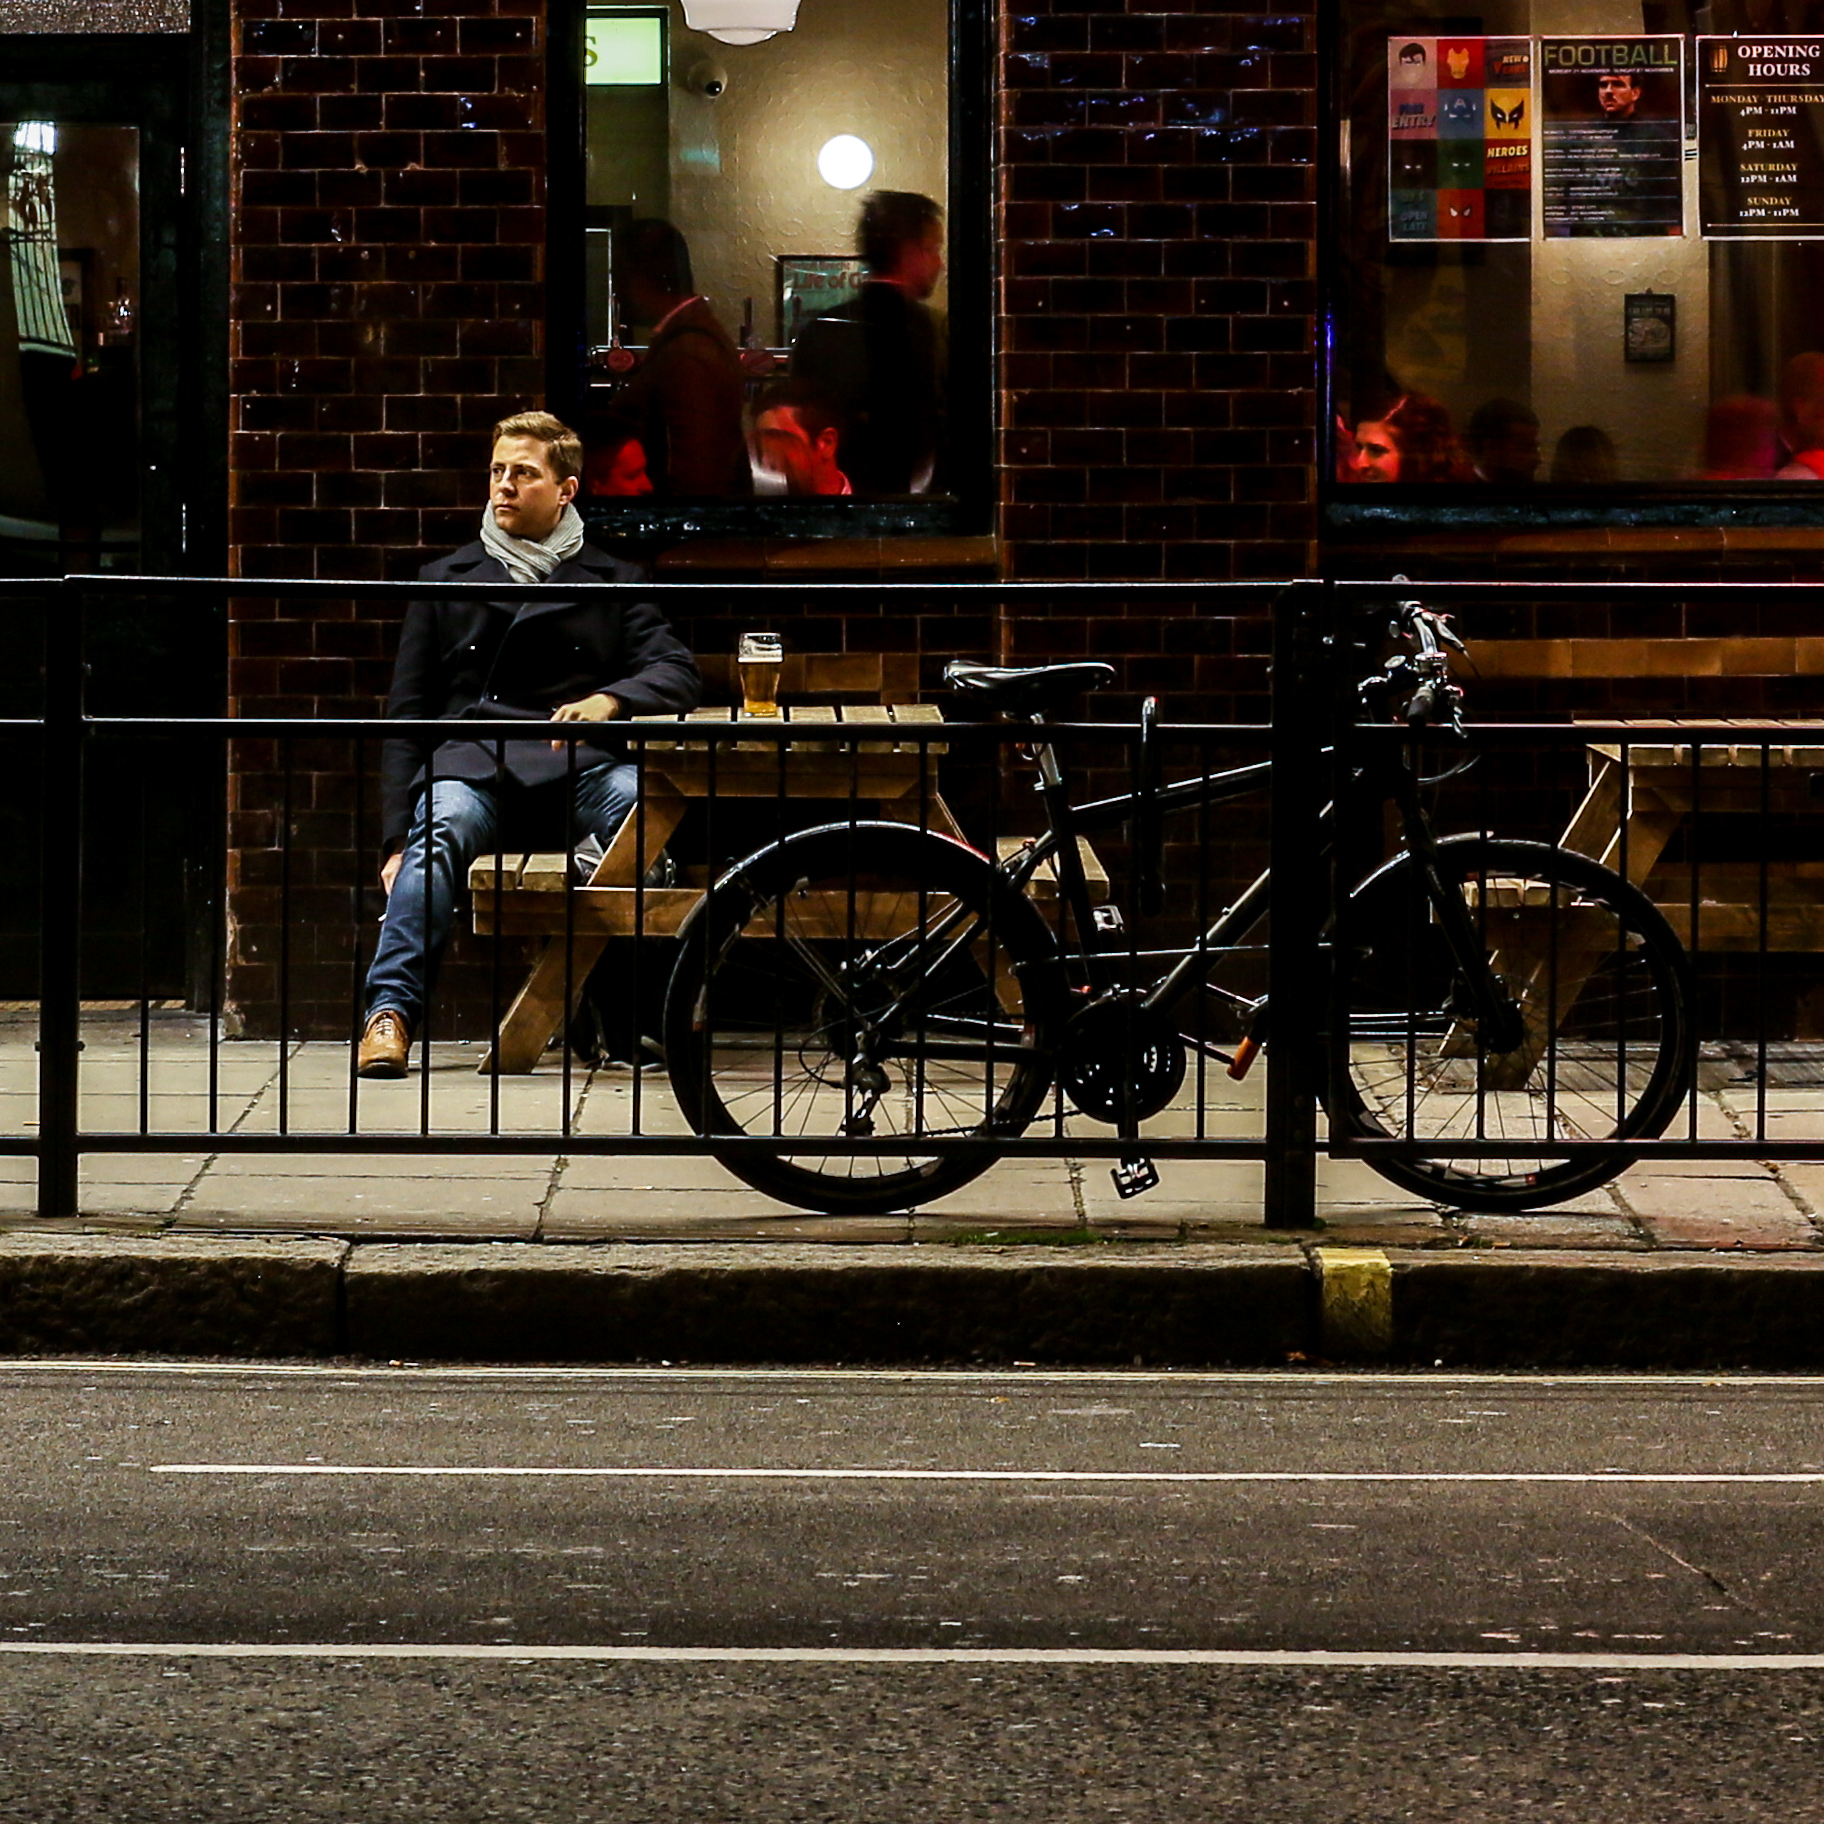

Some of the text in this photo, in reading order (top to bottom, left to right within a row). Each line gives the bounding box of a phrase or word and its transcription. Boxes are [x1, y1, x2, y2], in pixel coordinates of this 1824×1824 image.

[1543, 44, 1678, 67] FOOTBALL
[1737, 45, 1821, 58] OPENING
[1748, 63, 1811, 76] HOURS
[1711, 95, 1758, 103] MONDAY
[1740, 106, 1763, 115] 4PM
[1770, 106, 1797, 115] 11PM
[1748, 129, 1789, 137] FRIDAY
[1741, 140, 1765, 150] 4PM
[1772, 140, 1795, 149] 1AM
[1487, 145, 1528, 159] HEROES
[1739, 163, 1798, 172] SATURDAY
[1740, 174, 1767, 183] 12PM
[1775, 174, 1797, 183] 1AM
[1747, 197, 1792, 205] SUNDAY
[1739, 208, 1766, 217] 12PM
[1773, 208, 1799, 217] 11PM
[793, 272, 824, 289] Life
[828, 272, 848, 289] of
